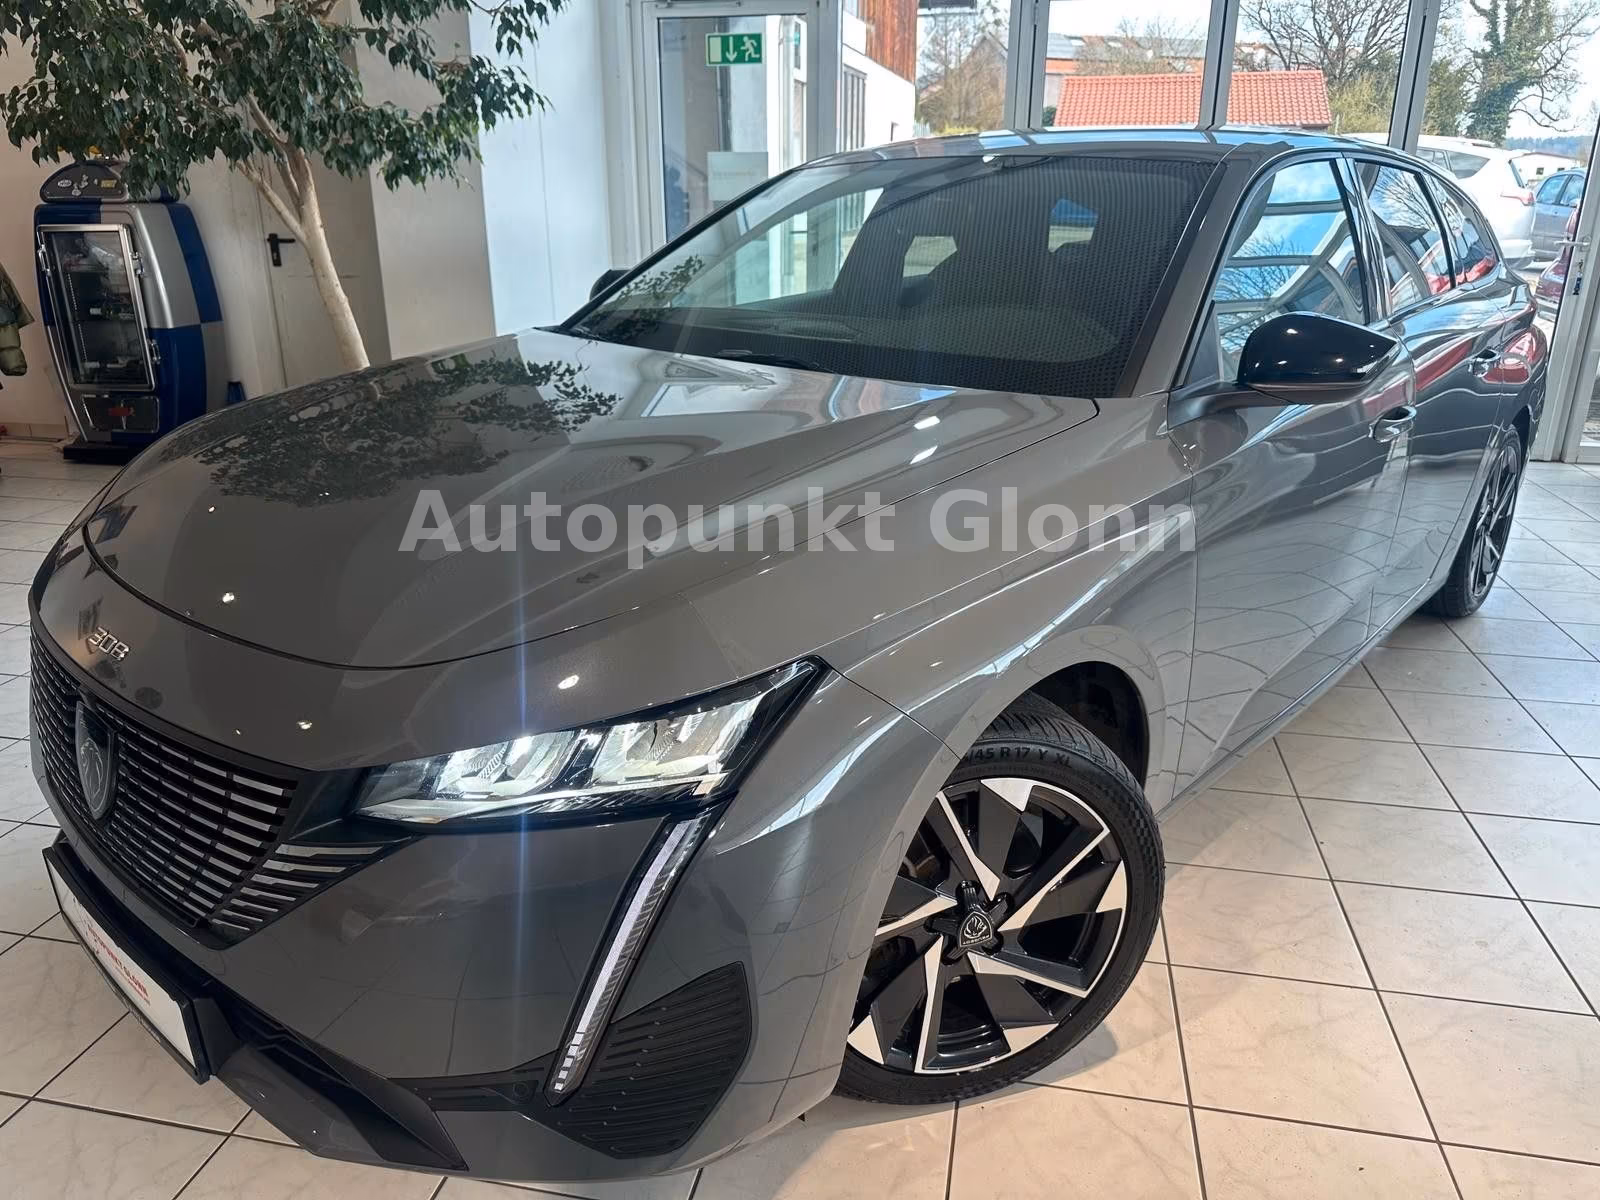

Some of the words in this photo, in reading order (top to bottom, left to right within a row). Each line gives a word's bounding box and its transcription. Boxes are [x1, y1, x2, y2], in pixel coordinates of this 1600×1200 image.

[89, 626, 129, 661] 308
[1000, 746, 1010, 758] R
[1015, 747, 1031, 759] 17
[1055, 752, 1072, 768] XL
